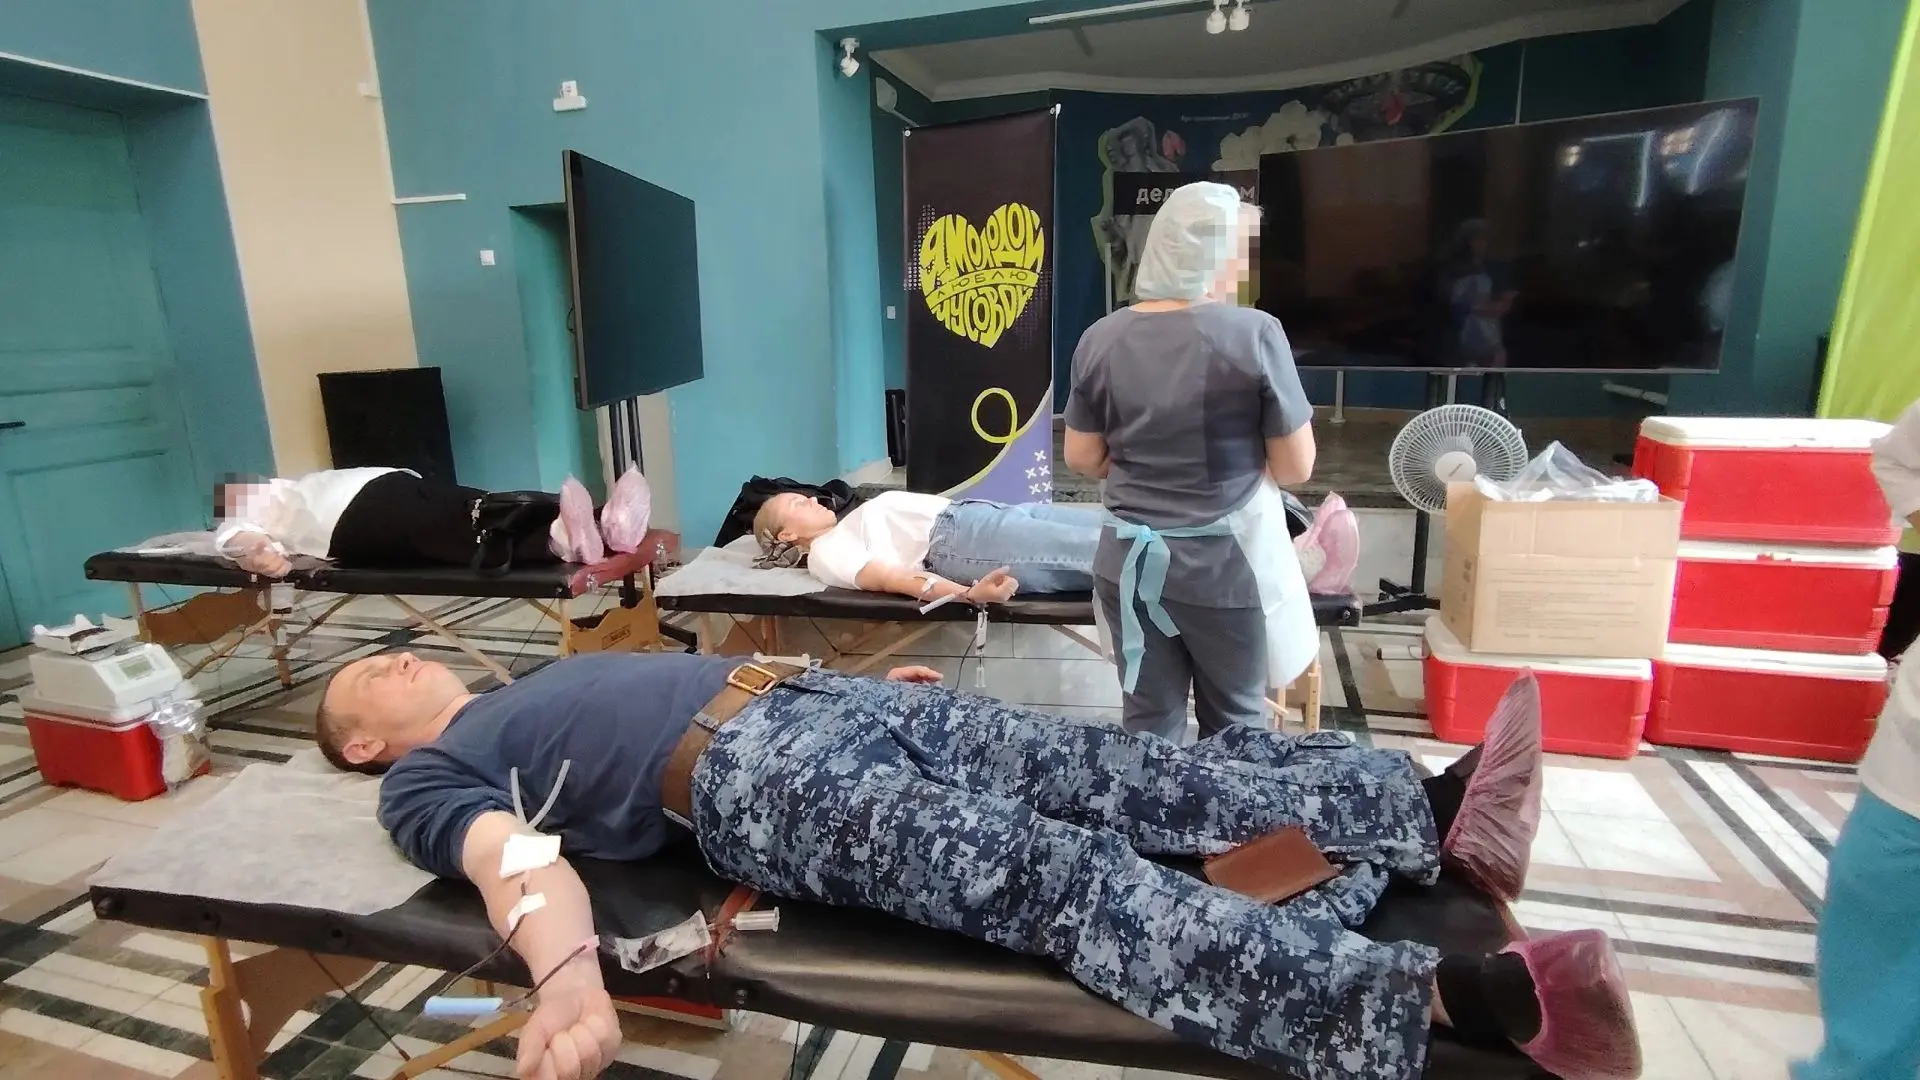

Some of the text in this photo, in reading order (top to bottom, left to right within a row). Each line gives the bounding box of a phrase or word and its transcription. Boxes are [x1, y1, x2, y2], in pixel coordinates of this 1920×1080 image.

[920, 202, 1045, 297] Я МОЛОДОЙ
[931, 284, 1034, 348] ЧУСОВОЙ
[935, 270, 1029, 300] ЛЮБЛЮ
